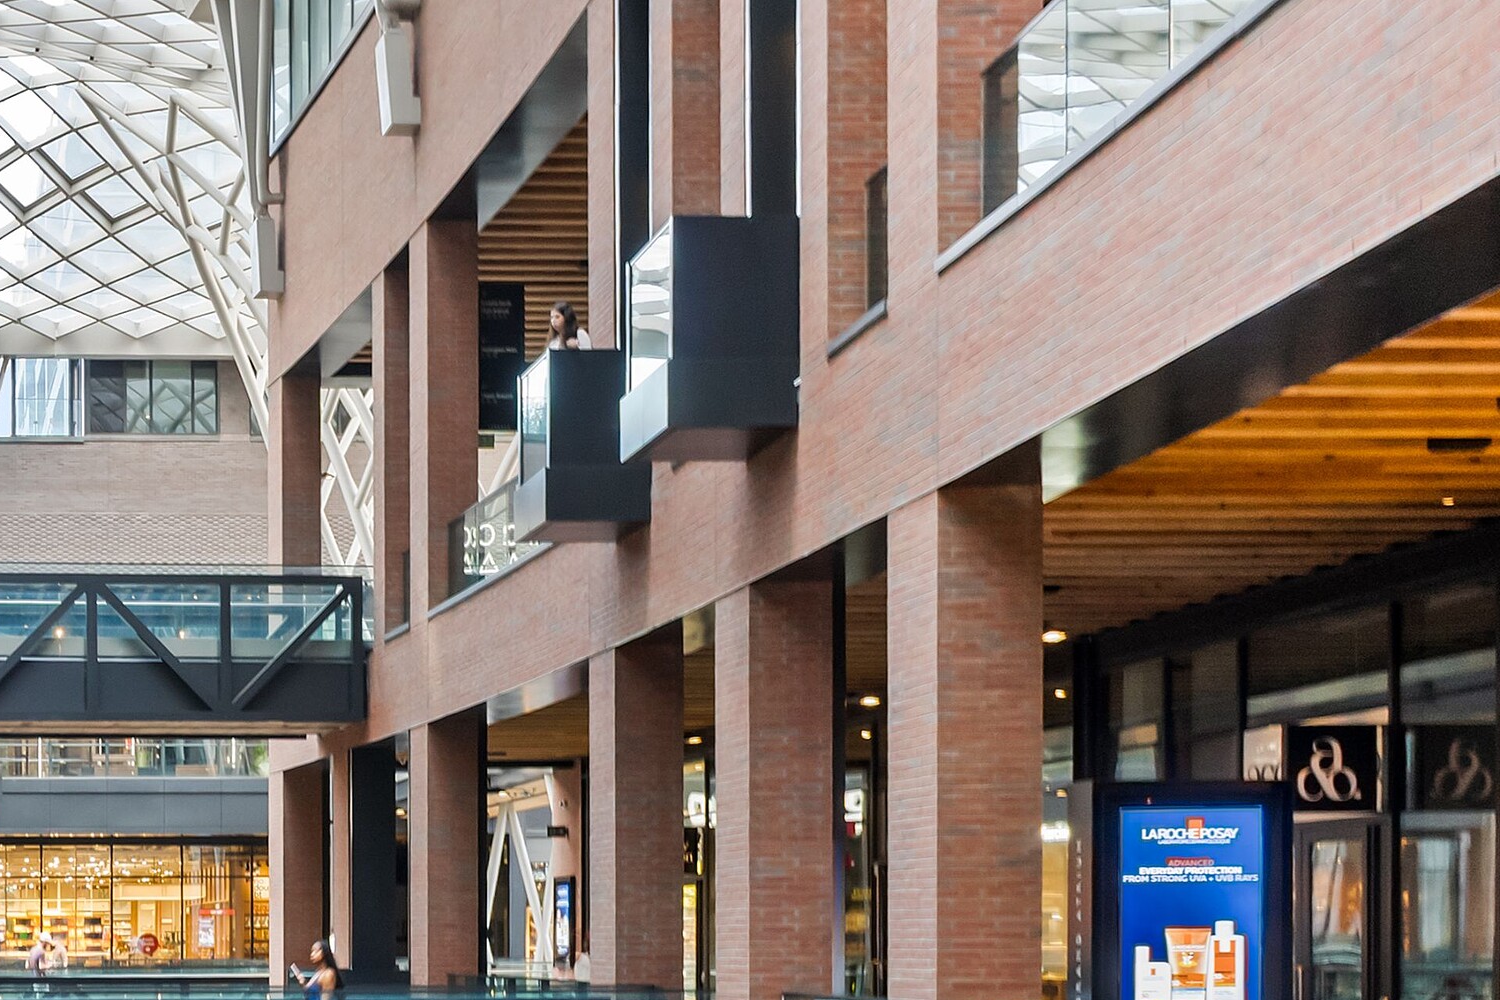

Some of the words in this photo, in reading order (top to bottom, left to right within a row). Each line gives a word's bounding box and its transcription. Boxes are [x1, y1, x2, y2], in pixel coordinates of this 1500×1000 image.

[1200, 827, 1239, 839] POSAY
[1138, 867, 1184, 875] EVERYDAY
[1184, 866, 1243, 874] PROTECTION
[1122, 875, 1149, 883] FROM
[1215, 874, 1234, 882] UVB
[1234, 874, 1259, 882] RAYS
